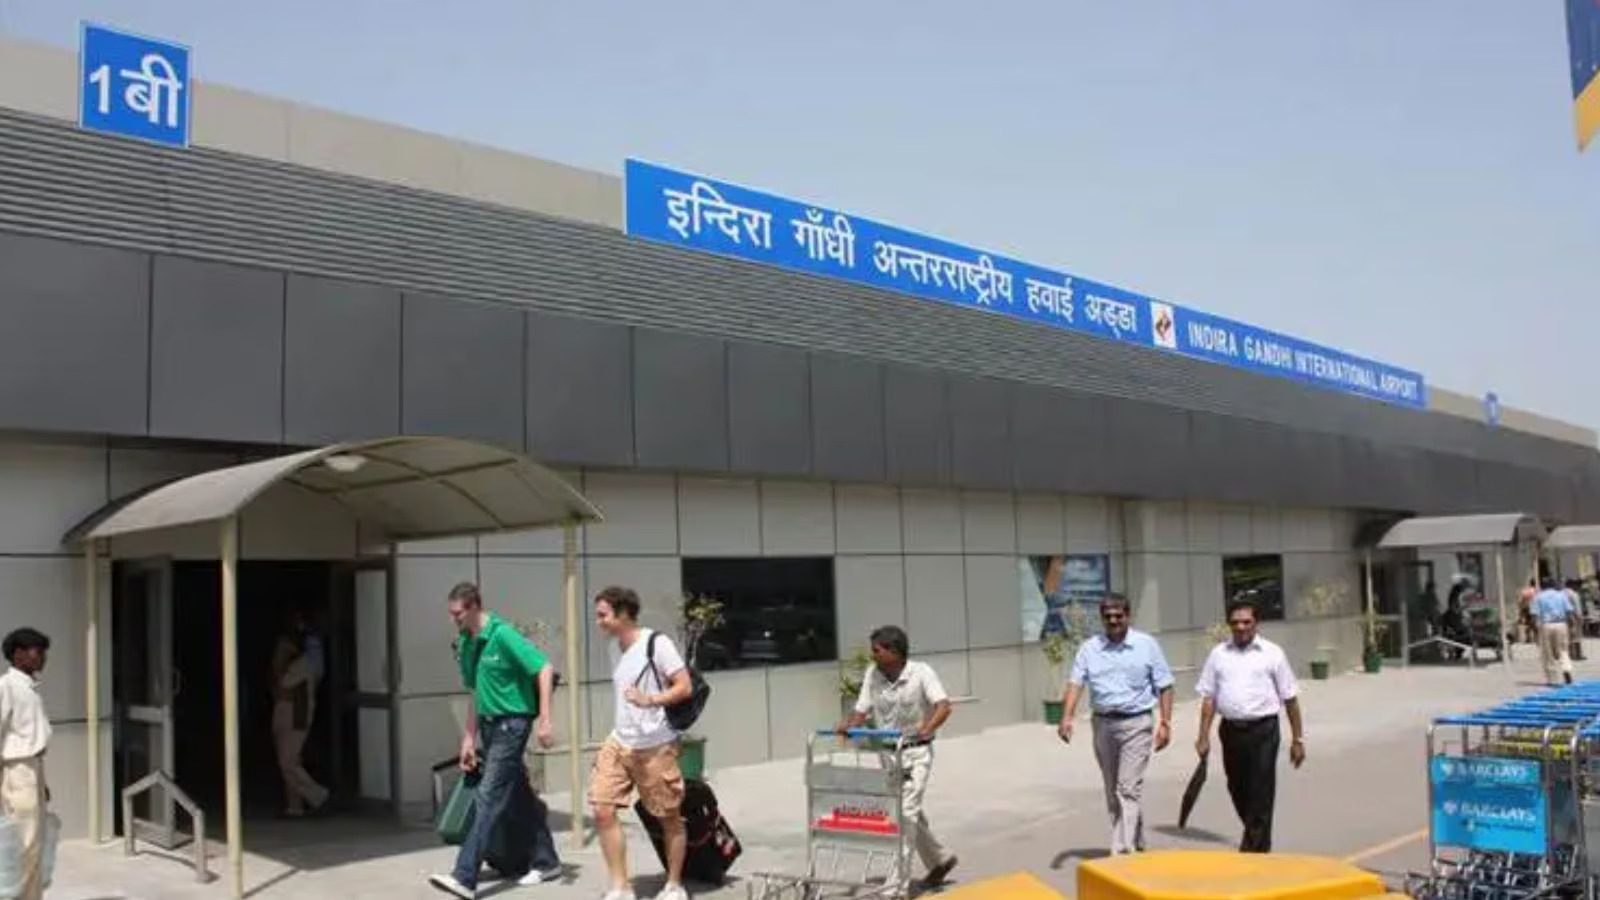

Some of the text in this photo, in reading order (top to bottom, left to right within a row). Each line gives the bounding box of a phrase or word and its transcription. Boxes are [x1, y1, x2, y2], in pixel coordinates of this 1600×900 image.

[663, 181, 773, 249] इन्दिरा
[791, 207, 856, 268] गाँधी
[873, 240, 1015, 305] अन्तरराष्ट्रीय
[1025, 277, 1075, 324] हवाई
[1187, 320, 1239, 358] INDIRA
[1243, 335, 1294, 371] GANDHI
[1460, 800, 1537, 822] BARCLAYS
